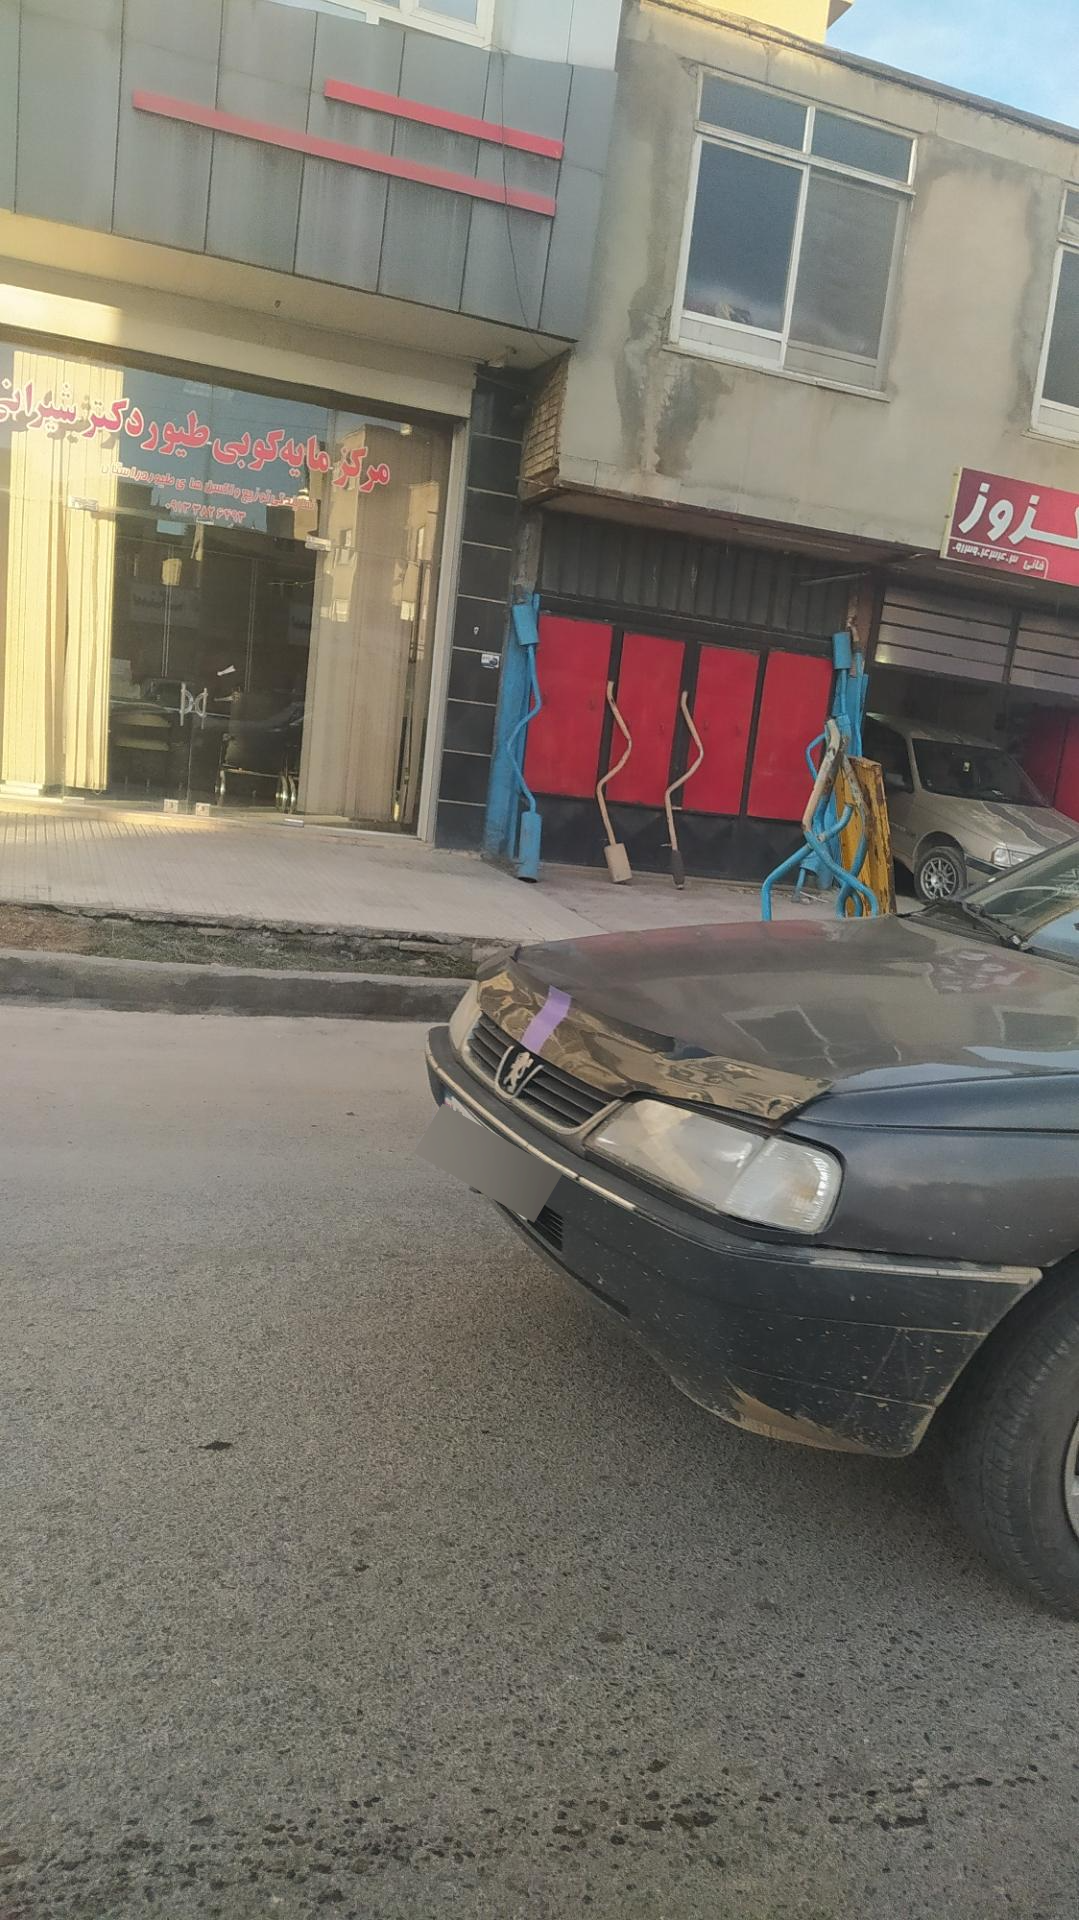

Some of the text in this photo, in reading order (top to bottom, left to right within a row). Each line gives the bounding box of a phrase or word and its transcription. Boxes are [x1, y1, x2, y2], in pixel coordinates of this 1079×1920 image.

[81, 397, 146, 440] دکتر
[141, 408, 210, 458] طیور
[332, 445, 391, 494] مرکز
